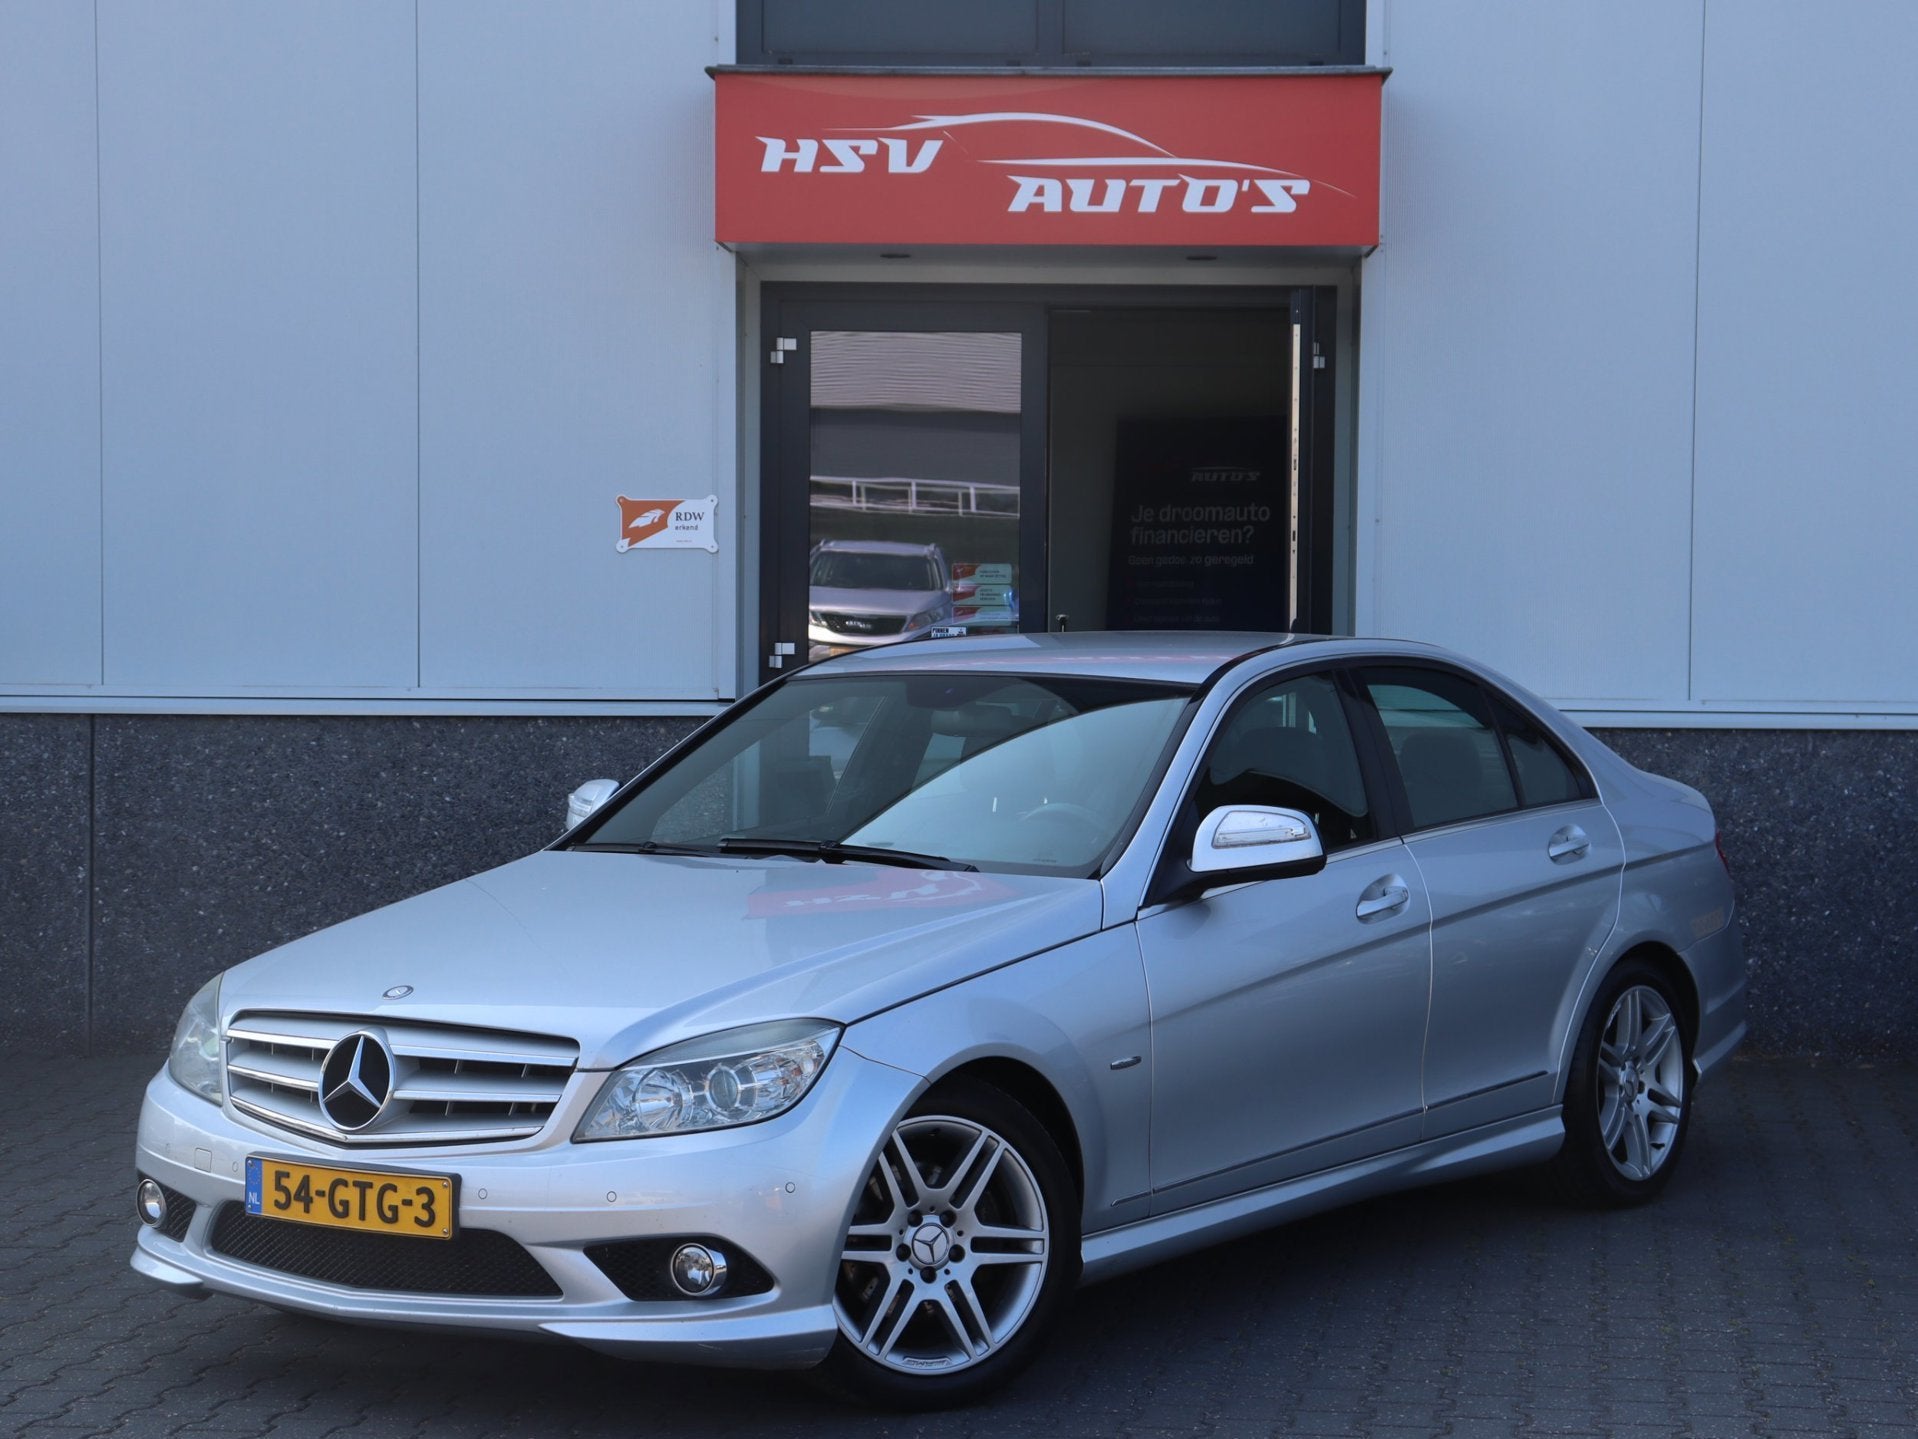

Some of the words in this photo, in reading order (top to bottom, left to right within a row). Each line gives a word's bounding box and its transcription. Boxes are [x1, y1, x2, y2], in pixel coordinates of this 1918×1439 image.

[755, 135, 943, 173] HSV
[1006, 173, 1310, 213] AUTO'S
[675, 511, 705, 522] RDW
[1131, 505, 1154, 522] Je
[1159, 502, 1271, 522] droomauto
[1130, 525, 1255, 545] financieren?
[248, 1191, 260, 1205] NL
[273, 1169, 436, 1228] 54-GTG-3
